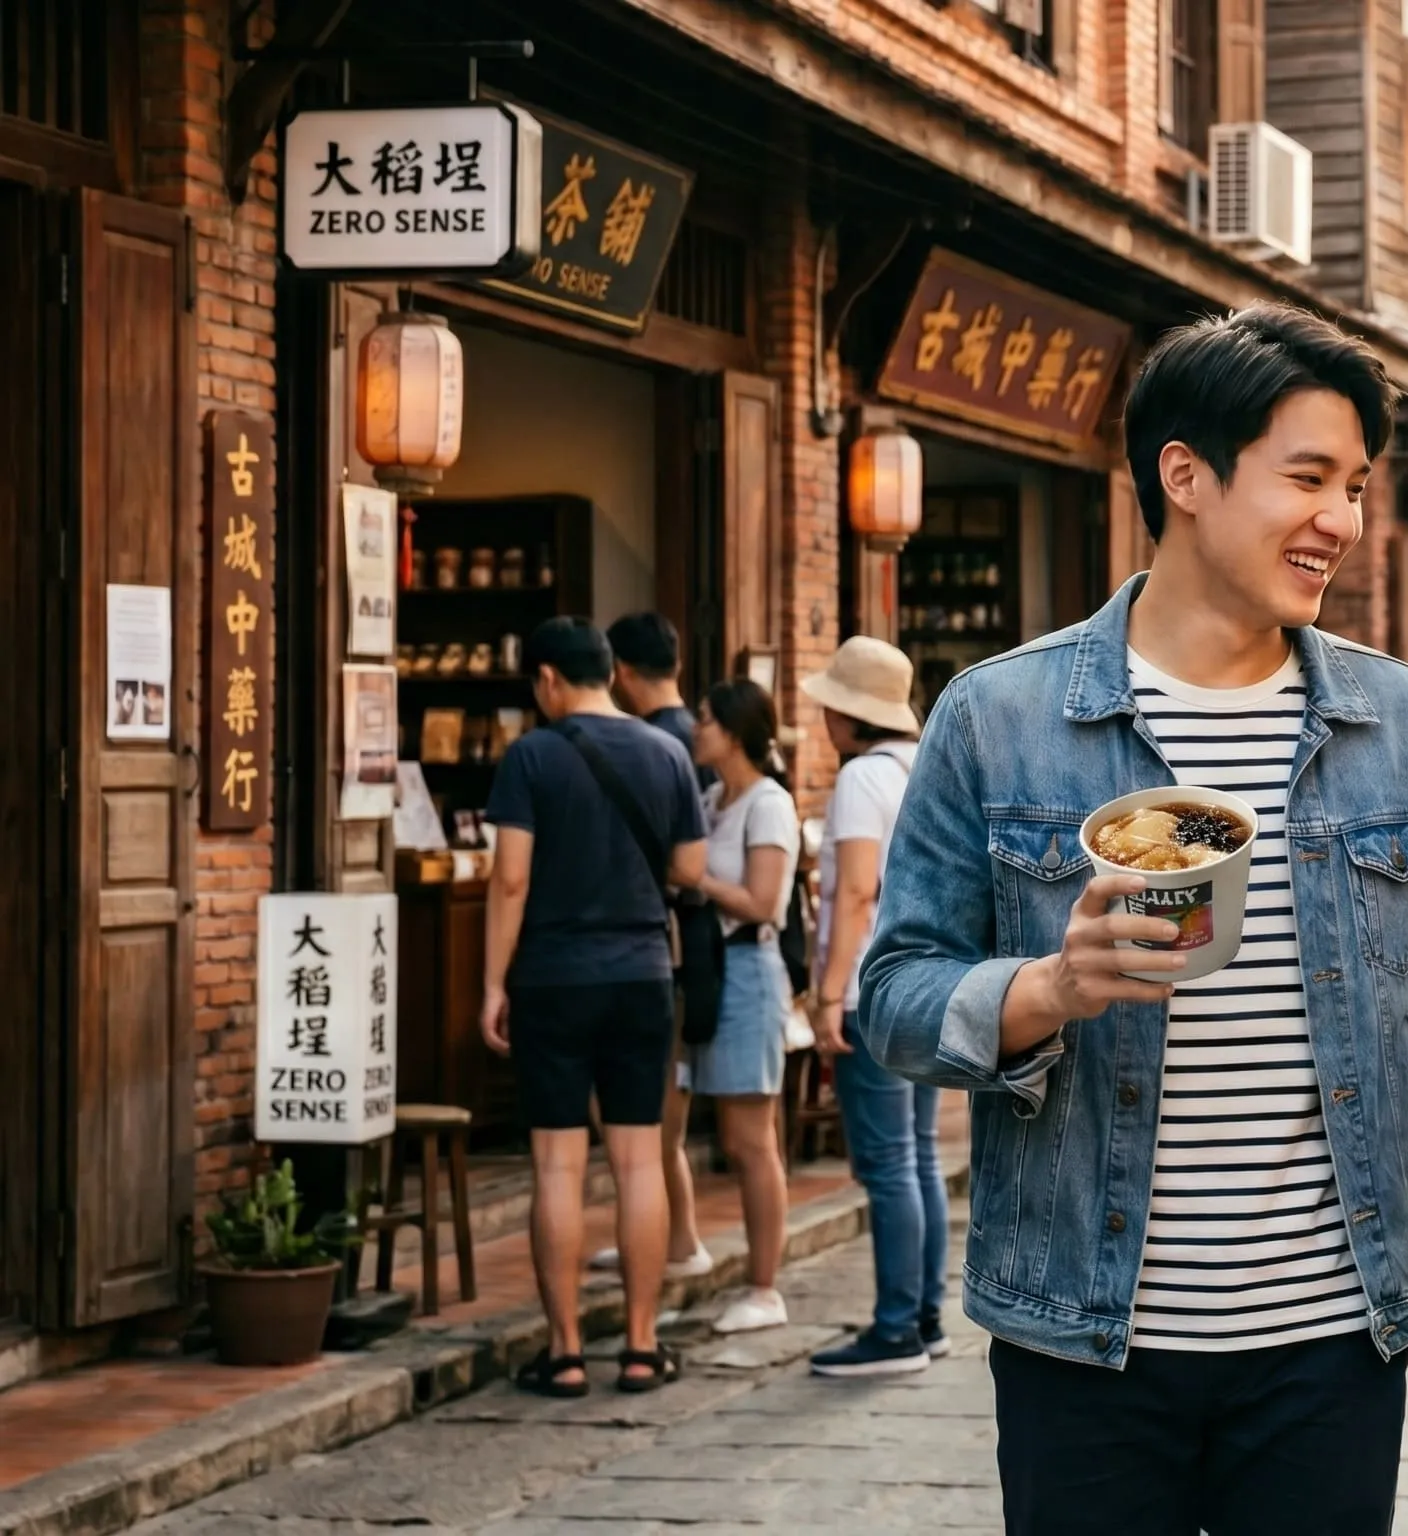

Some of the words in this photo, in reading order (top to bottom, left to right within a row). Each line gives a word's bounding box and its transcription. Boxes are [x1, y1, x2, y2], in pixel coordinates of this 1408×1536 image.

[311, 139, 487, 197] 大稻埕
[310, 210, 386, 236] ZERO
[395, 209, 486, 234] SENSE
[556, 262, 612, 301] SENSE
[222, 433, 262, 813] 古城中藥行
[286, 913, 332, 1057] 大稻埕
[271, 1068, 346, 1093] ZERO
[270, 1099, 347, 1122] SENSE
